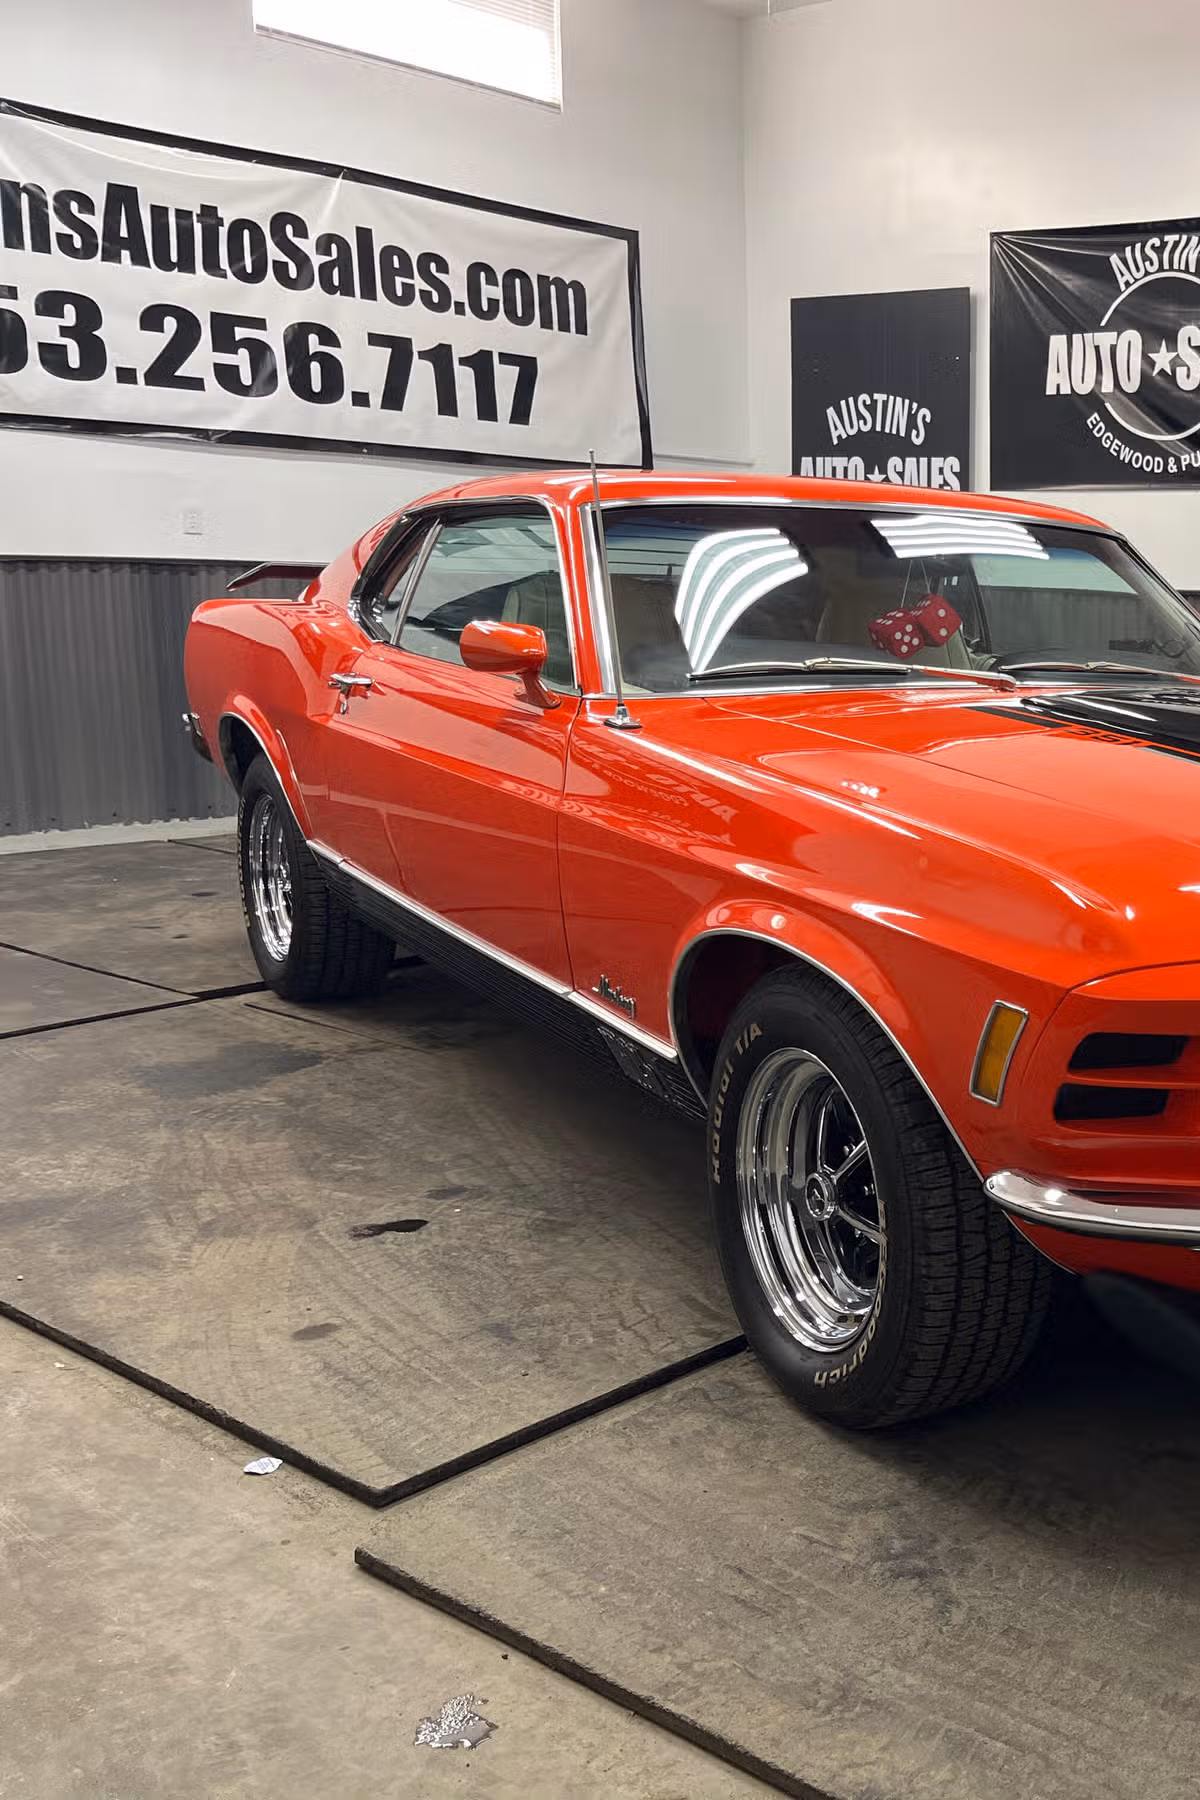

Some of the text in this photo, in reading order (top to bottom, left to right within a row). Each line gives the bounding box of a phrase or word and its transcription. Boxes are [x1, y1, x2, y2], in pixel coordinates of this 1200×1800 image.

[1046, 330, 1142, 395] AUTO
[826, 393, 931, 446] AUSTIN'S
[1086, 412, 1164, 473] EDGEWOOD
[1168, 457, 1178, 473] &
[736, 1024, 762, 1055] T/A
